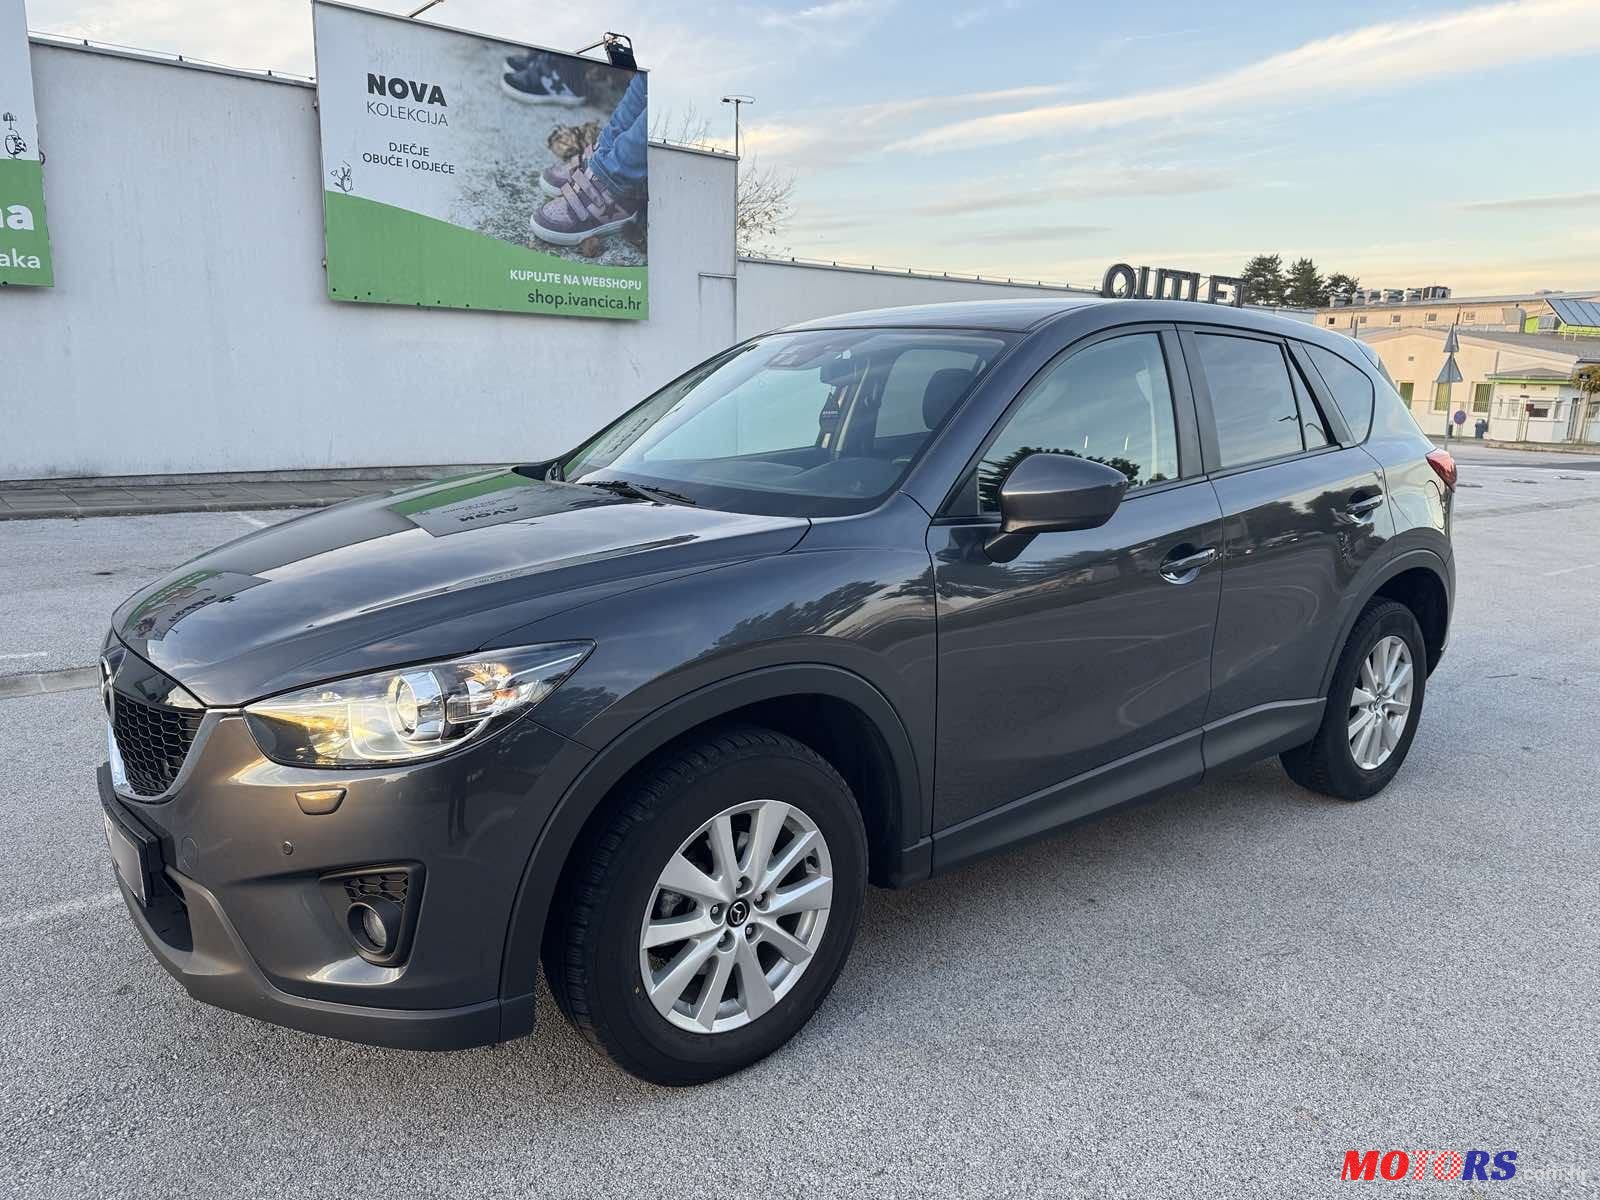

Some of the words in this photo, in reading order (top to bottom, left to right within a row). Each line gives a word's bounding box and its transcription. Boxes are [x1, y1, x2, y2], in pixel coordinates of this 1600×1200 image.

[367, 73, 447, 107] NOVA
[367, 101, 449, 126] KOLEKCIJA
[389, 142, 429, 157] DJEČJE
[362, 152, 403, 167] OBUĆE
[405, 159, 409, 168] I
[411, 160, 455, 174] ODJEĆE
[0, 204, 35, 231] a
[510, 269, 561, 283] KUPUJTE
[563, 274, 580, 286] NA
[582, 276, 642, 290] WEBSHOPU
[1102, 263, 1249, 308] OUTLET
[527, 289, 642, 311] shop.ivancica.hr
